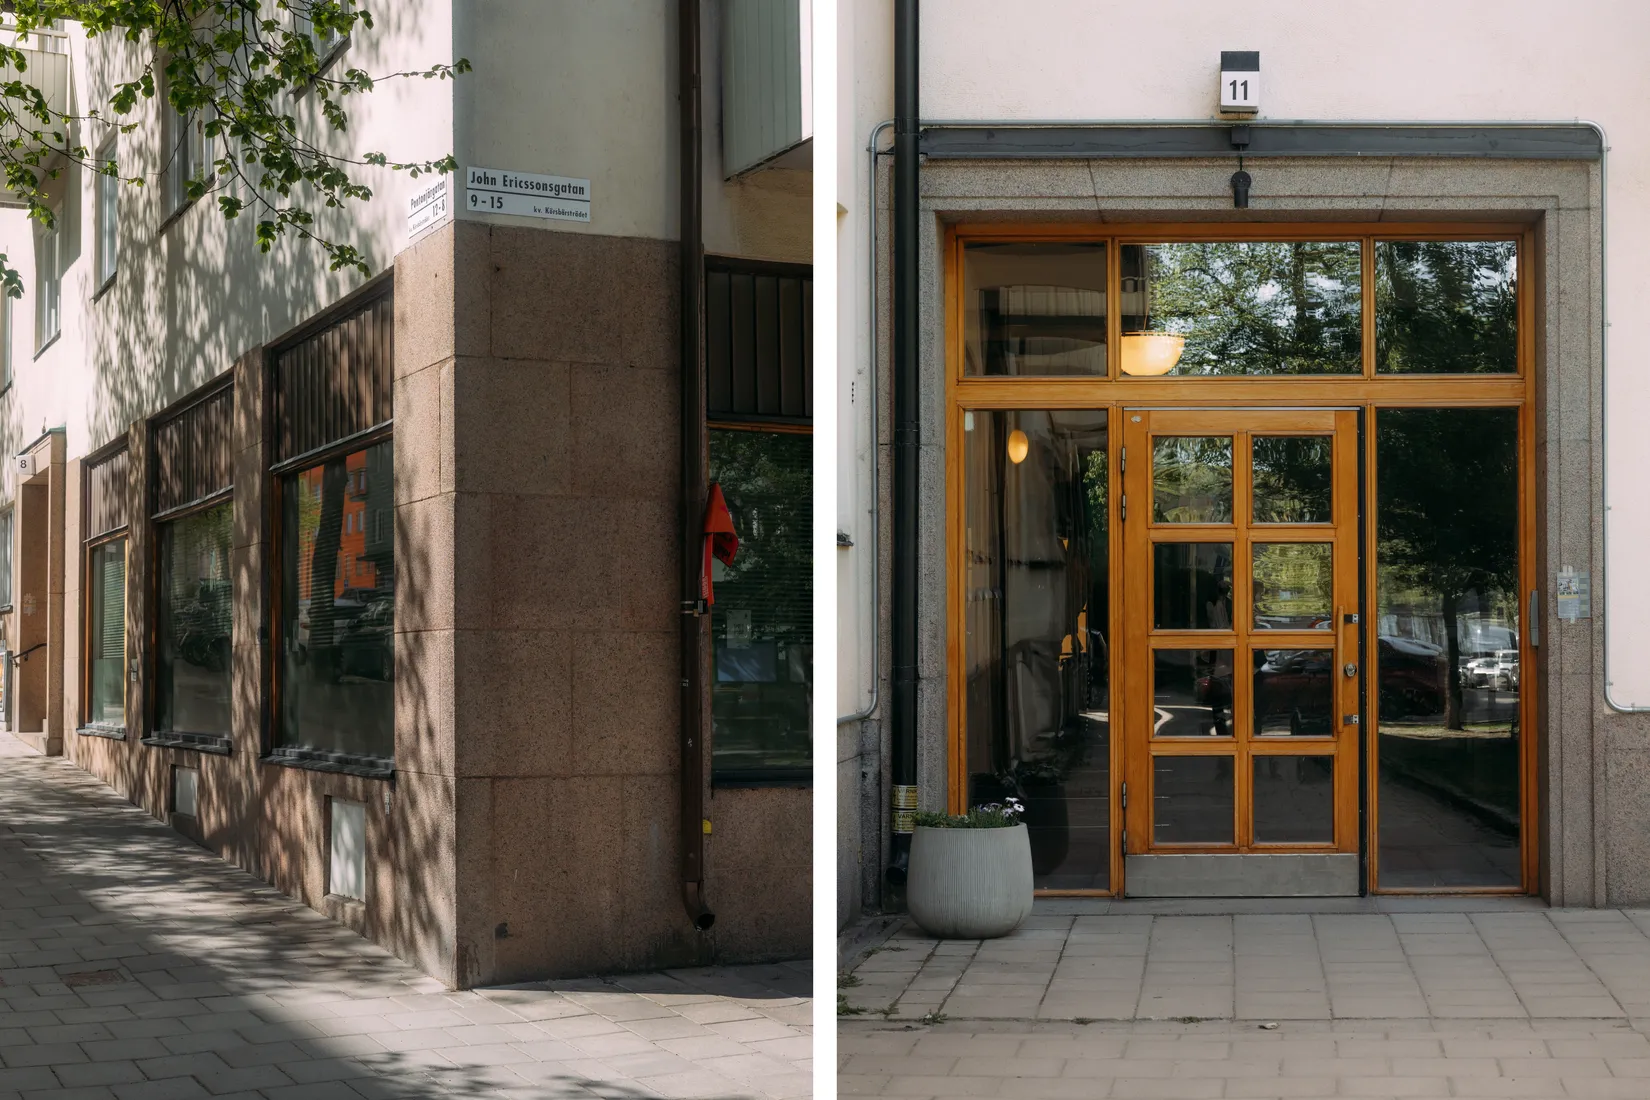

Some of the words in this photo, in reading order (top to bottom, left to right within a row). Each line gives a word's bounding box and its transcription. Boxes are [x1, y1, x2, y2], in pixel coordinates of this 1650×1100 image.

[1229, 79, 1249, 101] 11
[470, 171, 497, 187] John
[502, 174, 585, 196] Ericssonsgatan
[533, 205, 543, 214] kv.
[20, 459, 27, 469] 8
